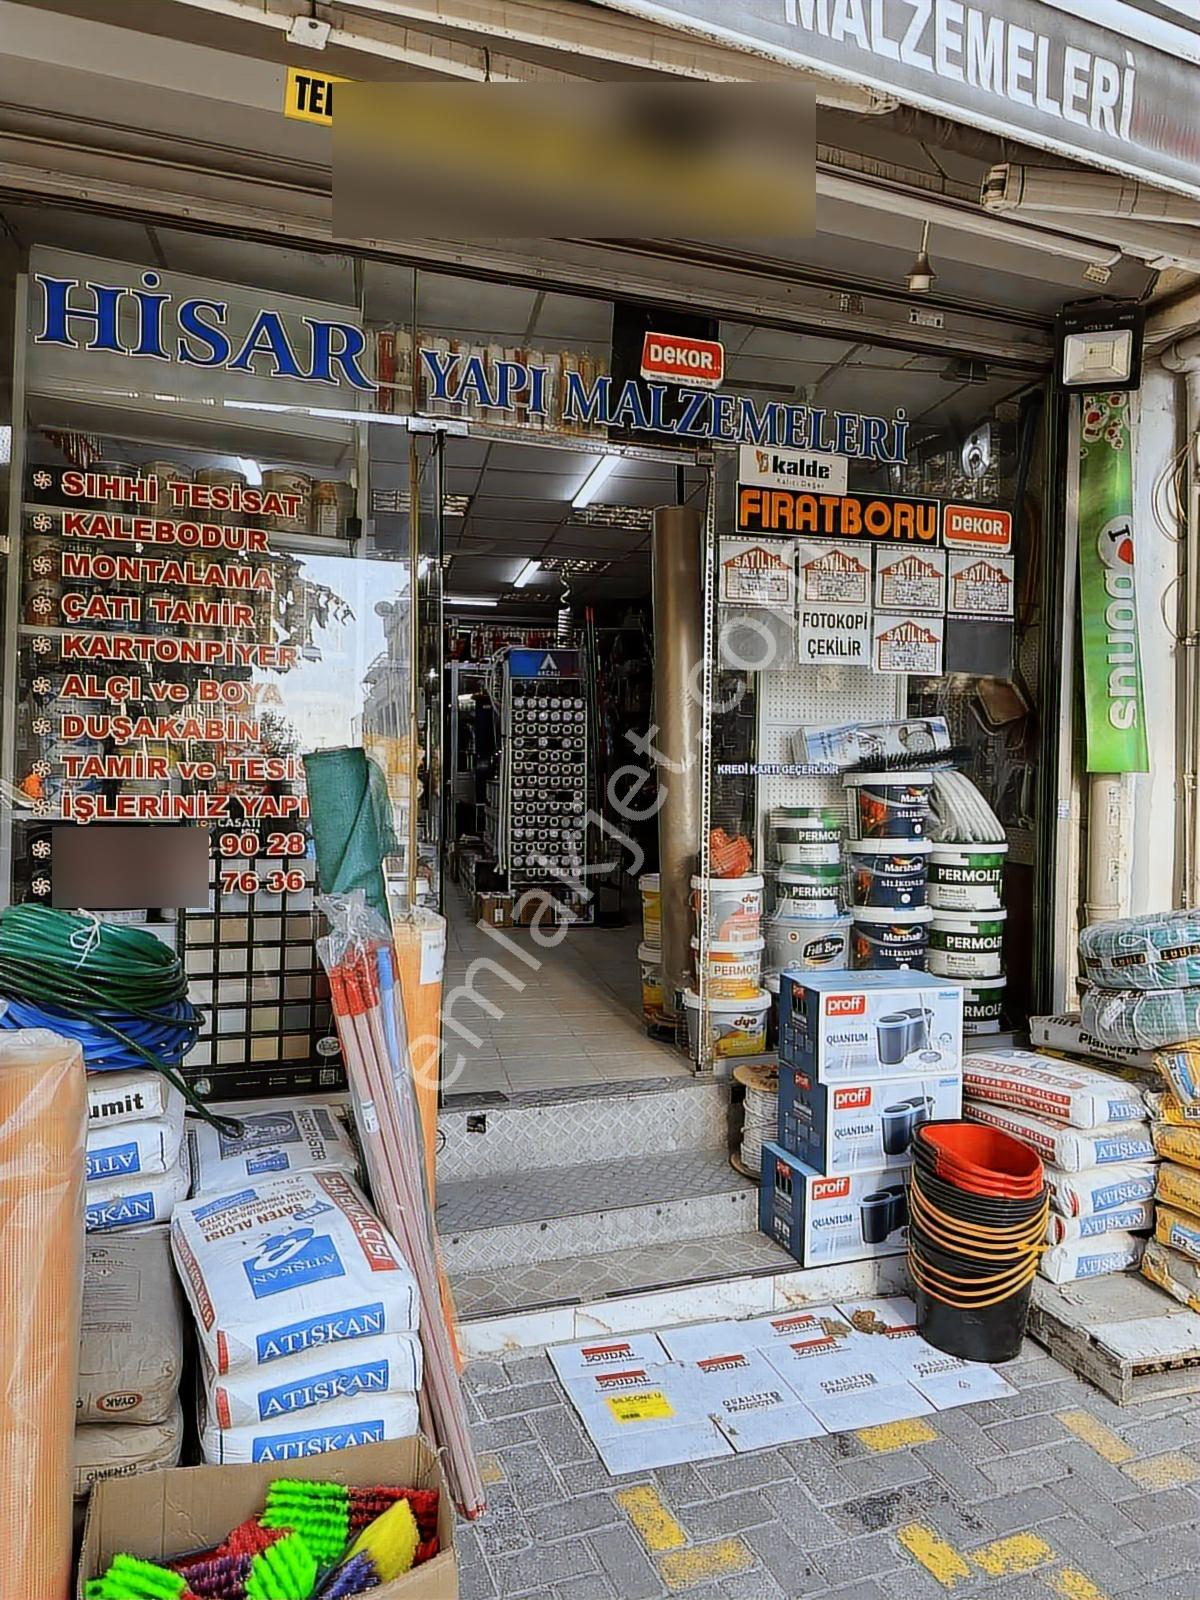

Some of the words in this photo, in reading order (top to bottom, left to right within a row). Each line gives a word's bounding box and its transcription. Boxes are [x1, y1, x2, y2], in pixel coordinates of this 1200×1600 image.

[34, 270, 379, 392] HİSAR
[419, 347, 549, 417] YAPI
[562, 370, 910, 464] MALZEMELERİ
[772, 455, 830, 479] kalde
[61, 470, 158, 503] SIHHİ
[167, 481, 303, 518] TESİSAT
[740, 489, 936, 541] FIRATBORU
[61, 511, 270, 552] KALEBODUR
[734, 550, 781, 569] SATILIK
[813, 553, 858, 571] SATILIK
[890, 559, 933, 577] SATILIK
[61, 552, 276, 591] MONTALAMA
[962, 563, 1002, 582] SATILIK
[61, 594, 140, 627] ÇATI
[149, 595, 255, 629] TAMİR
[802, 610, 869, 630] FOTOKOPİ
[886, 624, 930, 642] SATILIK
[61, 634, 299, 669] KARTONPİYER
[806, 636, 862, 659] ÇEKİLİR
[61, 675, 141, 704] ALÇI
[151, 682, 189, 701] ve
[199, 680, 283, 705] BOYA
[61, 714, 262, 745] DUŞAKABİN
[60, 752, 170, 781] TAMİR
[178, 761, 216, 780] ve
[717, 762, 748, 775] KREDİ
[750, 763, 780, 775] KARTI
[781, 762, 840, 777] GEÇERLİDİR
[60, 791, 226, 824] İŞLERİNİZ
[220, 832, 260, 856] 90
[266, 832, 306, 855] 28
[220, 870, 260, 894] 76
[266, 869, 306, 893] 36
[826, 996, 863, 1015] proff
[733, 1016, 758, 1028] dyo
[826, 1031, 869, 1046] QUANTUM
[834, 1088, 870, 1107] proff
[834, 1123, 874, 1140] QUANTUM
[812, 1178, 848, 1197] proff
[256, 1203, 304, 1223] SATEN
[811, 1212, 853, 1230] QUANTUM
[204, 1217, 253, 1242] ALÇISI
[347, 1208, 392, 1262] ALÇISI
[253, 1253, 337, 1285] ATISKAN
[261, 1310, 382, 1360] ATISKAN
[585, 1351, 635, 1363] SOUDAL
[795, 1343, 843, 1356] SOUDAL
[702, 1361, 751, 1374] SOUDAL
[263, 1369, 385, 1416] ATISKAN
[600, 1376, 651, 1389] SOUDAL
[105, 1396, 136, 1408] OYAK
[258, 1429, 381, 1463] ATISKAN
